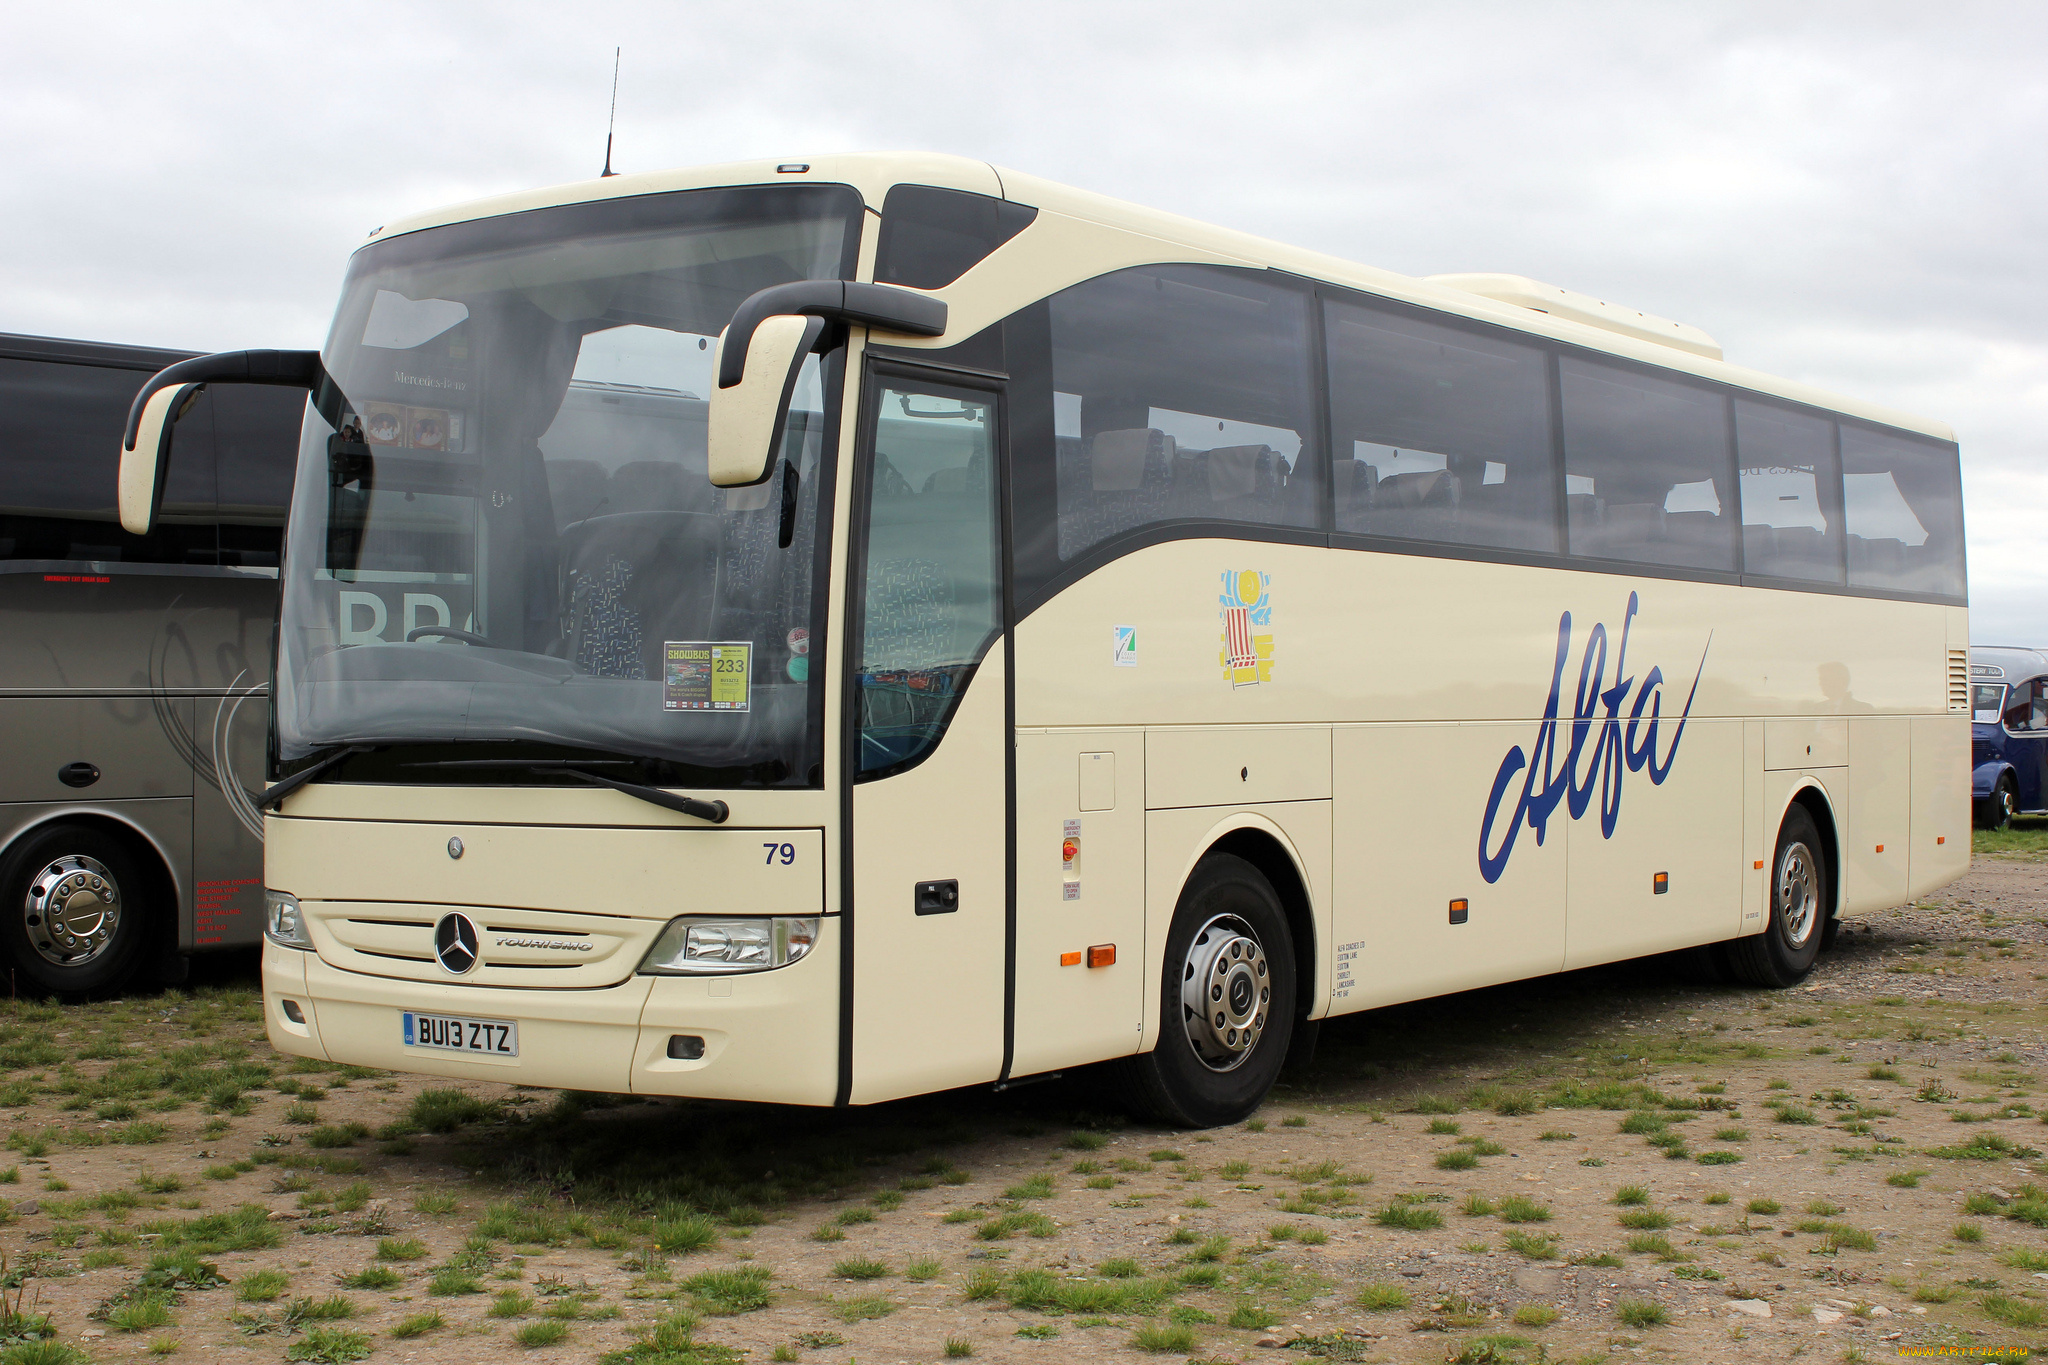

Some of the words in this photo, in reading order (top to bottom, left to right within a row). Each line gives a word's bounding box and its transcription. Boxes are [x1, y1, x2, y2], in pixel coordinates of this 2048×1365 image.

[394, 371, 467, 390] Mercedes-Benz
[668, 650, 710, 660] SHOWBUS
[716, 659, 744, 673] 233
[1479, 590, 1714, 884] Alfa
[763, 843, 795, 865] 79
[496, 937, 593, 951] TOURISMO
[419, 1017, 463, 1048] BU13
[468, 1022, 510, 1052] ZTZ
